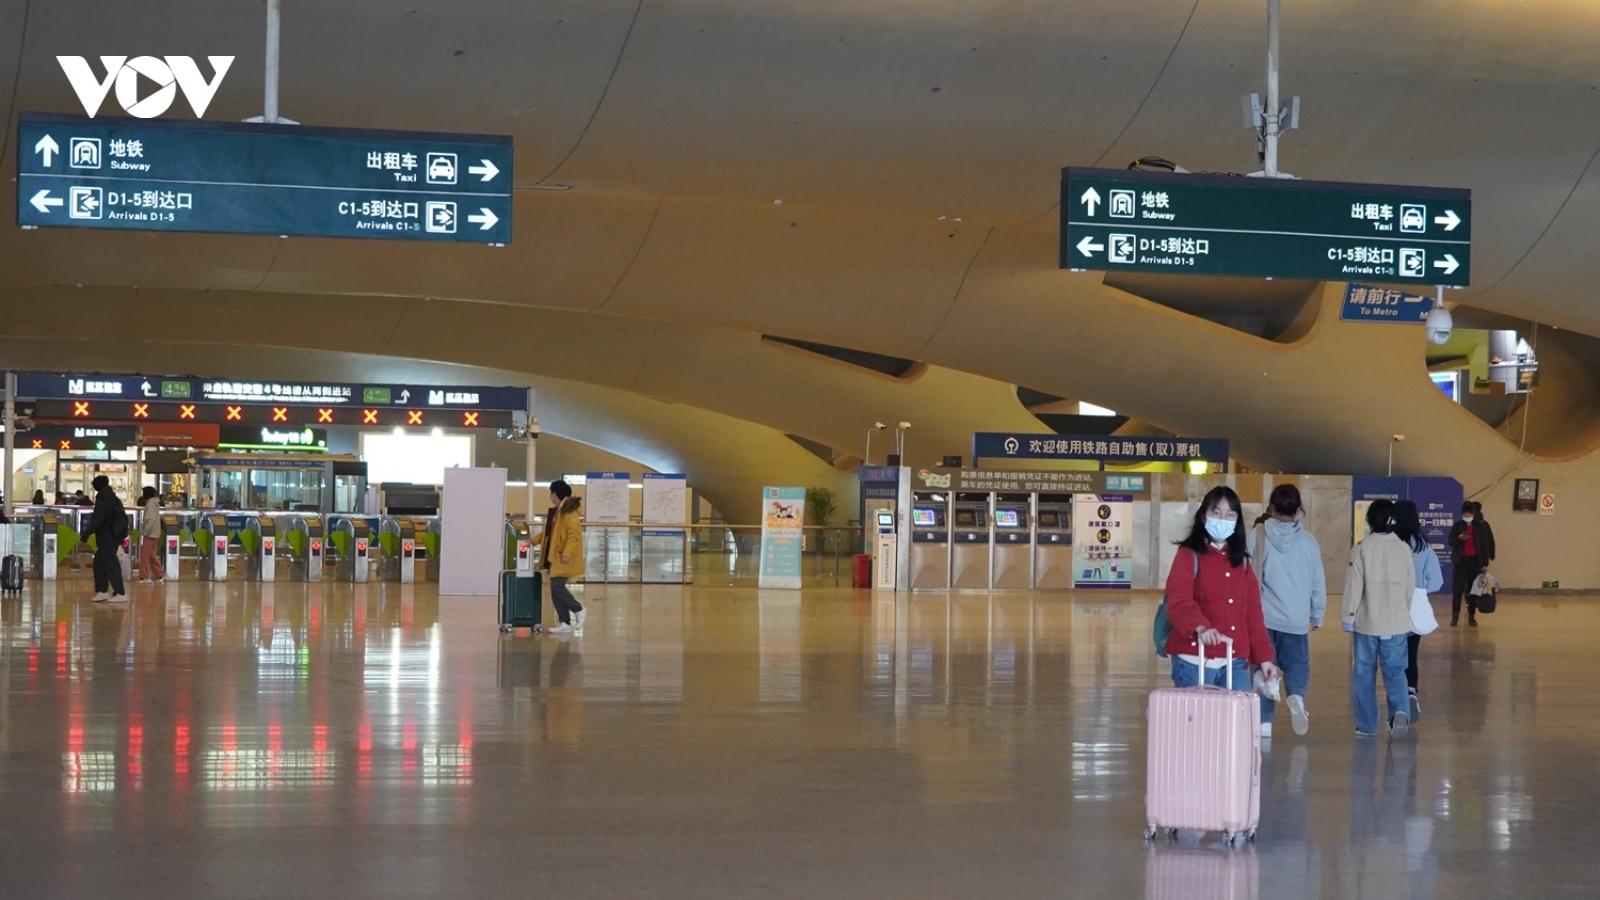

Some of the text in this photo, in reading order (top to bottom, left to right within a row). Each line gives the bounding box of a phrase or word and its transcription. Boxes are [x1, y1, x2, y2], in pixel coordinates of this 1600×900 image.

[109, 139, 144, 158] 地铁
[110, 160, 150, 172] Subway
[366, 151, 418, 171] 出租车
[394, 172, 417, 182] Taxi
[108, 190, 193, 210] D1-5到达口
[1140, 191, 1170, 209] 地铁
[108, 210, 175, 222] Arrivals D1-5
[338, 199, 419, 219] C1-5到达口
[1142, 210, 1176, 221] Subway
[1350, 203, 1394, 221] 出租车
[356, 220, 421, 232] Arrivals C1-5
[1373, 221, 1393, 231] Taxi
[1140, 238, 1209, 256] D1-5到达口
[1140, 256, 1195, 266] Arrivals D1-5
[1327, 246, 1394, 264] C1-5到达口
[1342, 265, 1373, 274] Arrivals
[1349, 287, 1402, 305] 请前行
[1360, 306, 1399, 316] To Metro
